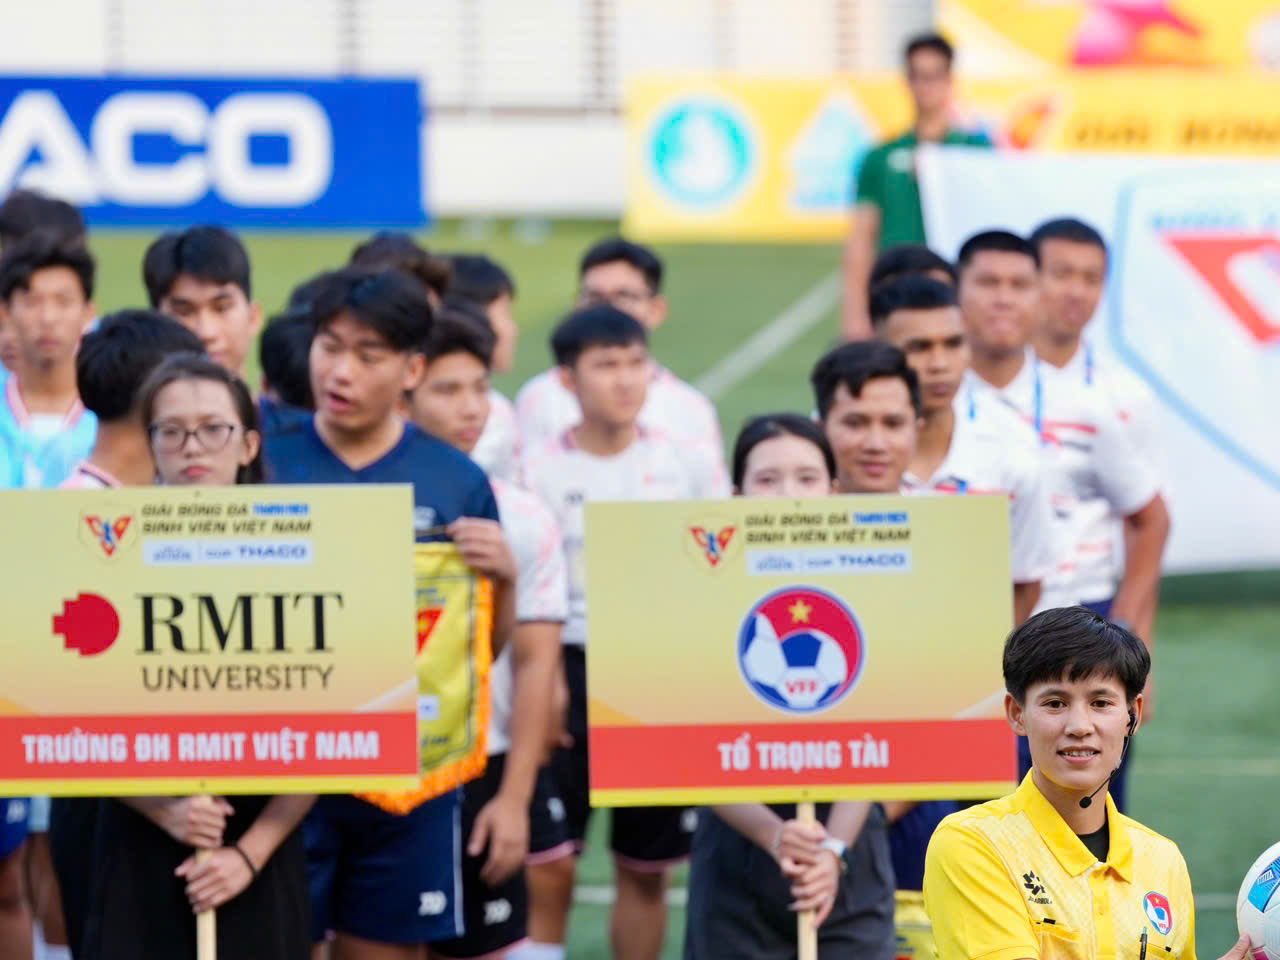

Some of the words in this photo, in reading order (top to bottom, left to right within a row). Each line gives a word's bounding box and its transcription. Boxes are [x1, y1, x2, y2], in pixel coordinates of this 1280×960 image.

[272, 520, 312, 533] NAM
[872, 529, 911, 542] NAM
[239, 545, 307, 558] THACO
[838, 553, 905, 567] THACO
[134, 590, 345, 656] RMIT
[142, 664, 335, 691] UNIVERSITY
[785, 680, 820, 694] VFF
[21, 727, 129, 764] TRƯỜNG
[134, 734, 171, 763] ĐH
[178, 732, 247, 762] RMIT
[252, 727, 309, 765] VIỆT
[315, 730, 381, 760] NAM
[718, 732, 751, 771] TỔ
[757, 740, 842, 774] TRỌNG
[848, 734, 890, 768] TÀI
